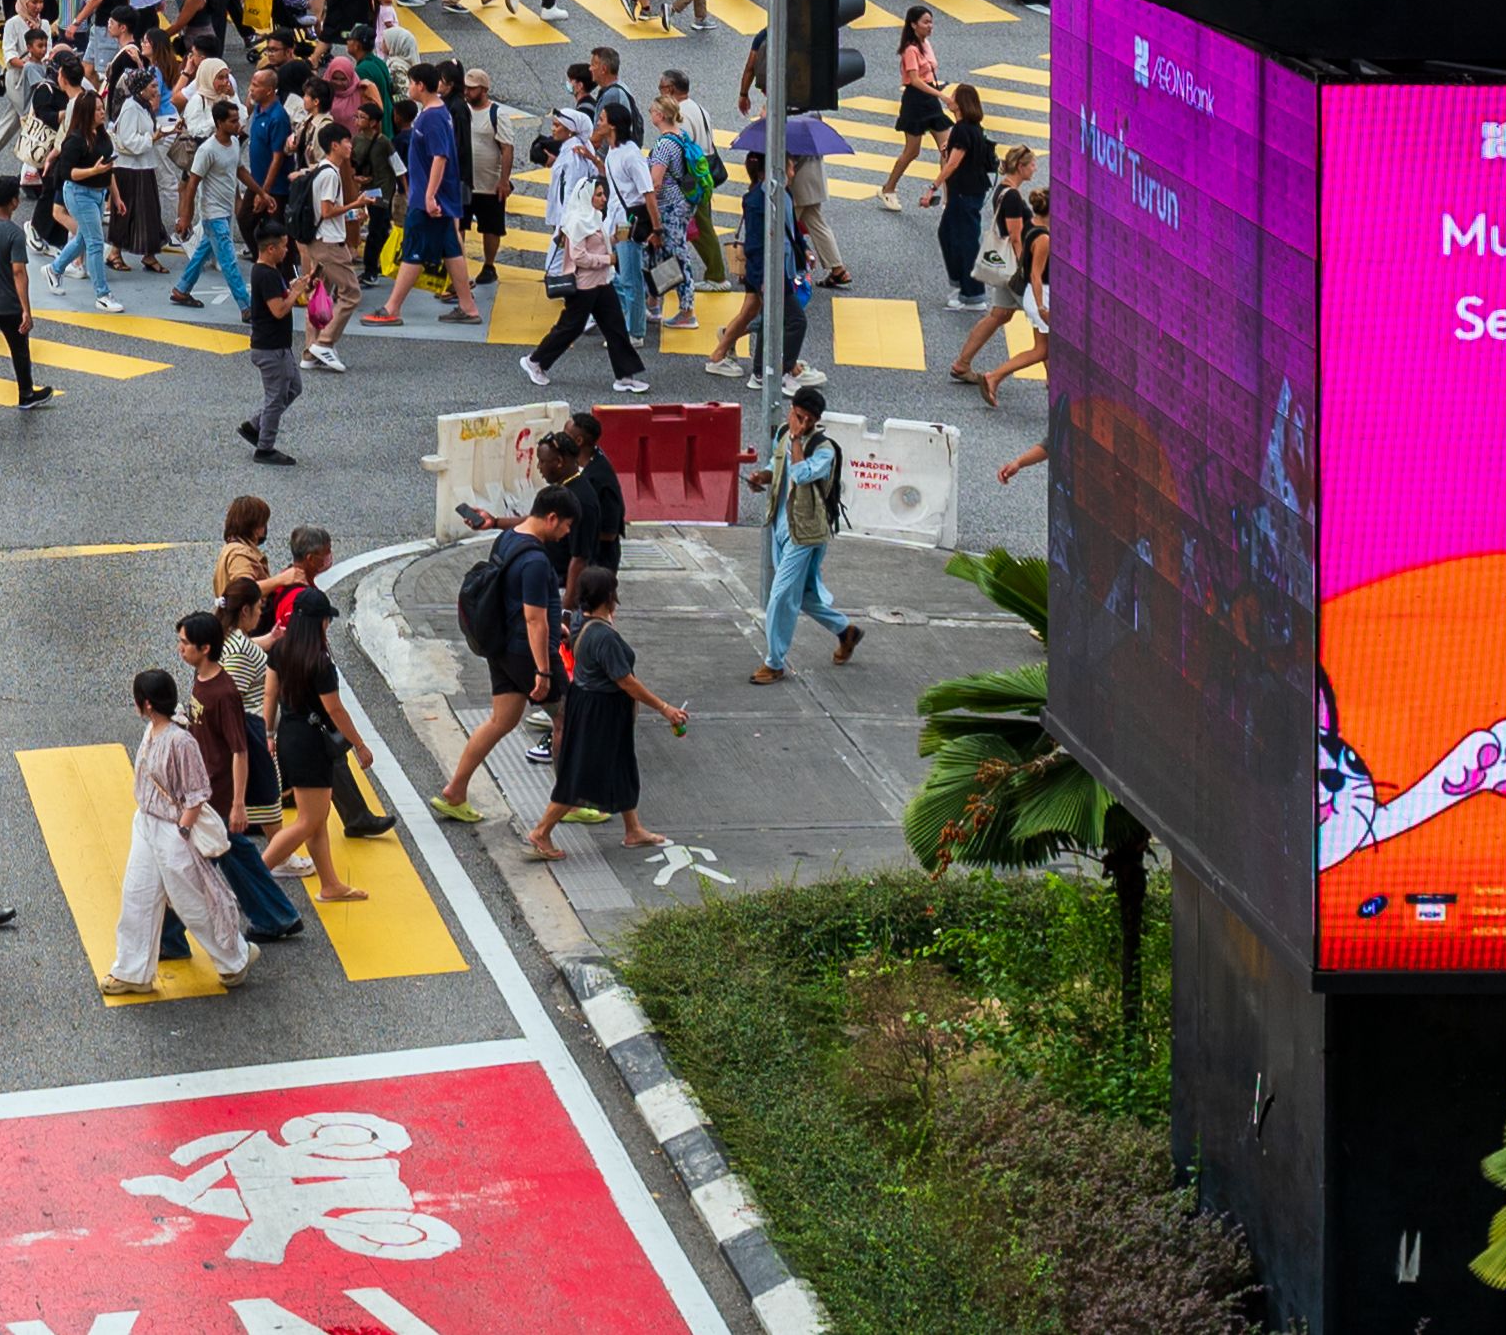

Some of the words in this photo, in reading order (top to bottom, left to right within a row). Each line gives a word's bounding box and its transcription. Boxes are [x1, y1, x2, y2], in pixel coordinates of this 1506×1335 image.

[1185, 69, 1216, 118] Bank
[1080, 103, 1127, 177] Muat
[1127, 150, 1178, 230] Turun
[849, 459, 893, 471] WARDEN
[853, 471, 890, 481] TRAFIK
